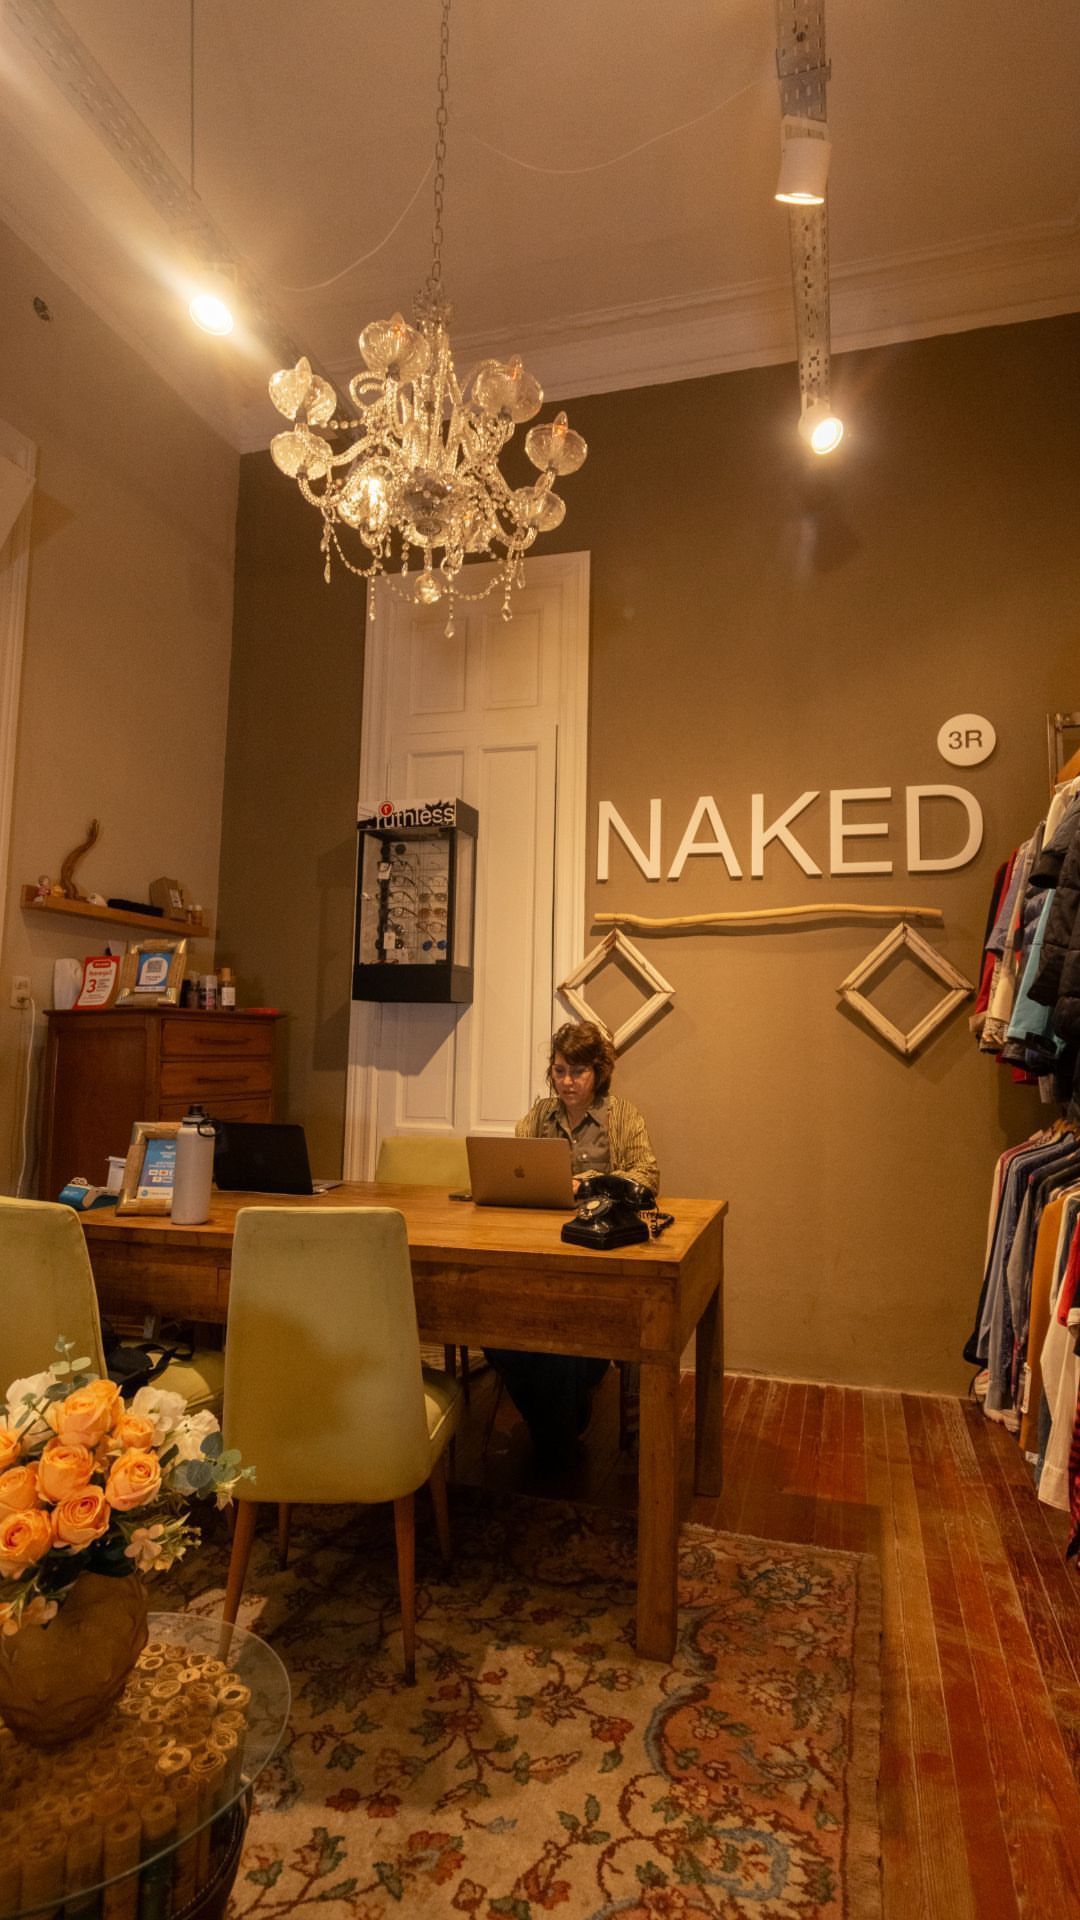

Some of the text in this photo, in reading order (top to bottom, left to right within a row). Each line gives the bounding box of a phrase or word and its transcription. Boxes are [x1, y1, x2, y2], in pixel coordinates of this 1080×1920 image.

[948, 730, 983, 750] 3R
[375, 807, 454, 829] ruthless
[597, 784, 984, 881] NAKED
[87, 979, 97, 993] 3
